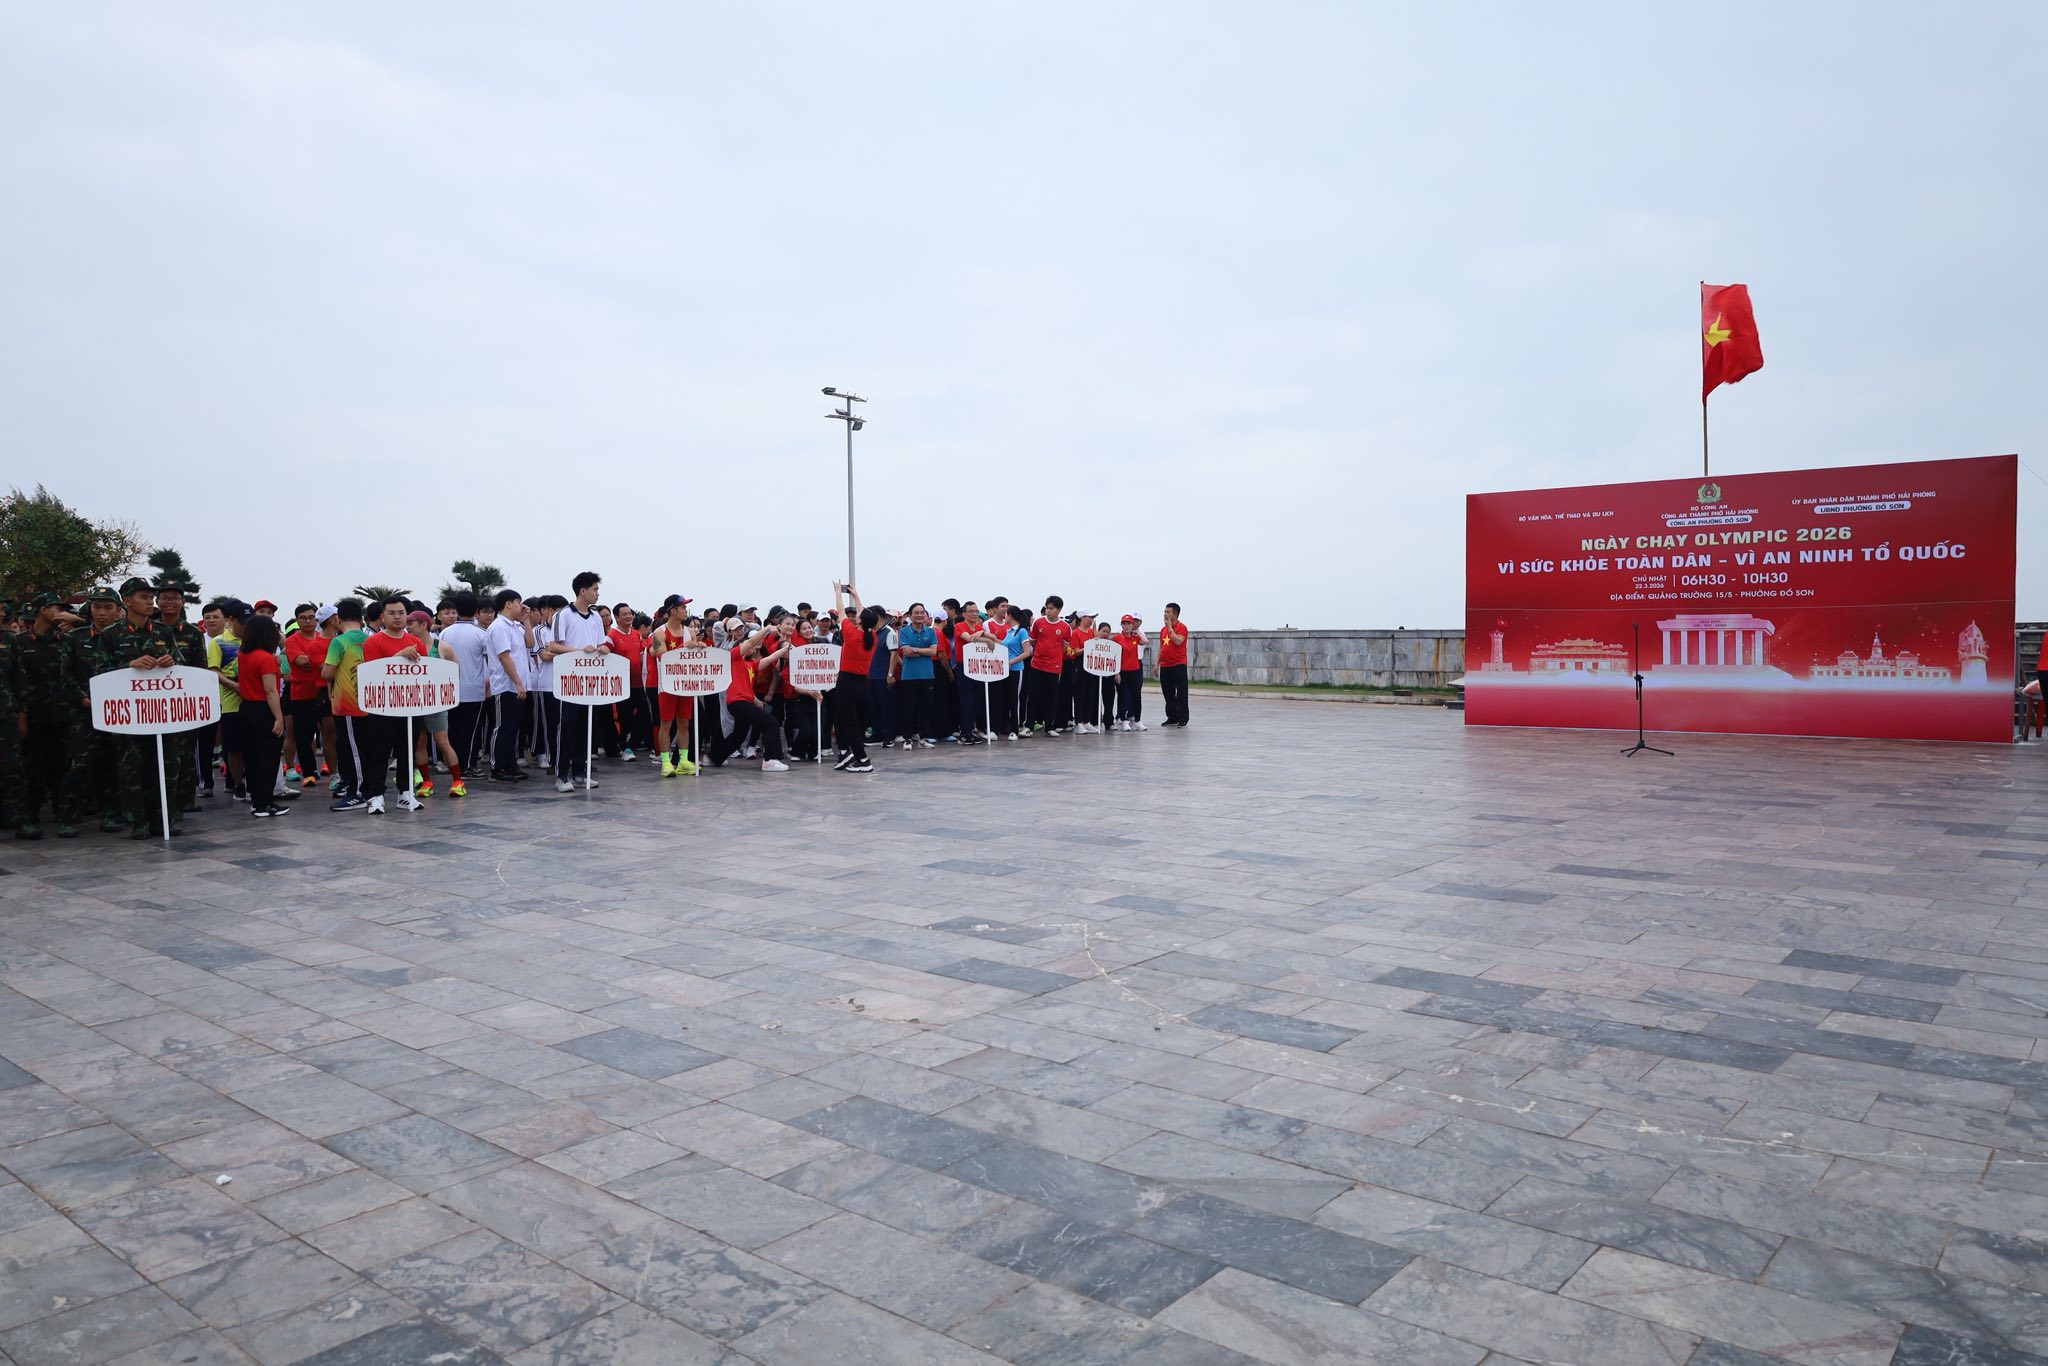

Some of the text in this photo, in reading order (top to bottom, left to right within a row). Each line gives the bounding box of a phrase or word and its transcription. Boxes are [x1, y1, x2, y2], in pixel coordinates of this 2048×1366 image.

[1581, 526, 1852, 551] NGÀY CHẠY OLYMPIC 2026
[1498, 560, 1514, 574] VÌ
[1520, 558, 1554, 573] SỨC
[1560, 556, 1609, 572] KHỎE
[1614, 554, 1664, 570] TOÀN
[1672, 552, 1711, 568] DÂN
[1734, 550, 1755, 566] VÌ
[1762, 551, 1790, 564] AN
[1800, 548, 1853, 563] NINH
[1861, 542, 1890, 562] TỔ
[1899, 540, 1966, 562] QUỐC
[1649, 574, 1667, 582] NHẬT
[1681, 574, 1726, 586] 06H30
[1743, 572, 1788, 584] 10H30
[1610, 593, 1624, 601] ĐỊA
[1648, 592, 1678, 600] QUẢNG
[1740, 589, 1777, 598] PHƯỜNG
[805, 645, 829, 655] KHỐI
[574, 654, 605, 667] KHỐI
[665, 662, 723, 675] TRƯỜNG THCS & THPT
[1094, 654, 1105, 671] DÂN
[130, 671, 184, 692] KHỐI
[561, 670, 584, 696] TRƯỜNG
[585, 676, 599, 696] THPT
[610, 674, 623, 696] SƠN
[364, 681, 377, 709] CÁN
[377, 681, 386, 712] BỘ
[389, 681, 405, 708] CÔNG
[423, 680, 436, 706] VIÊN
[440, 677, 456, 706] CHỨC
[104, 692, 211, 726] CBCS TRUNG ĐOÀN 50
